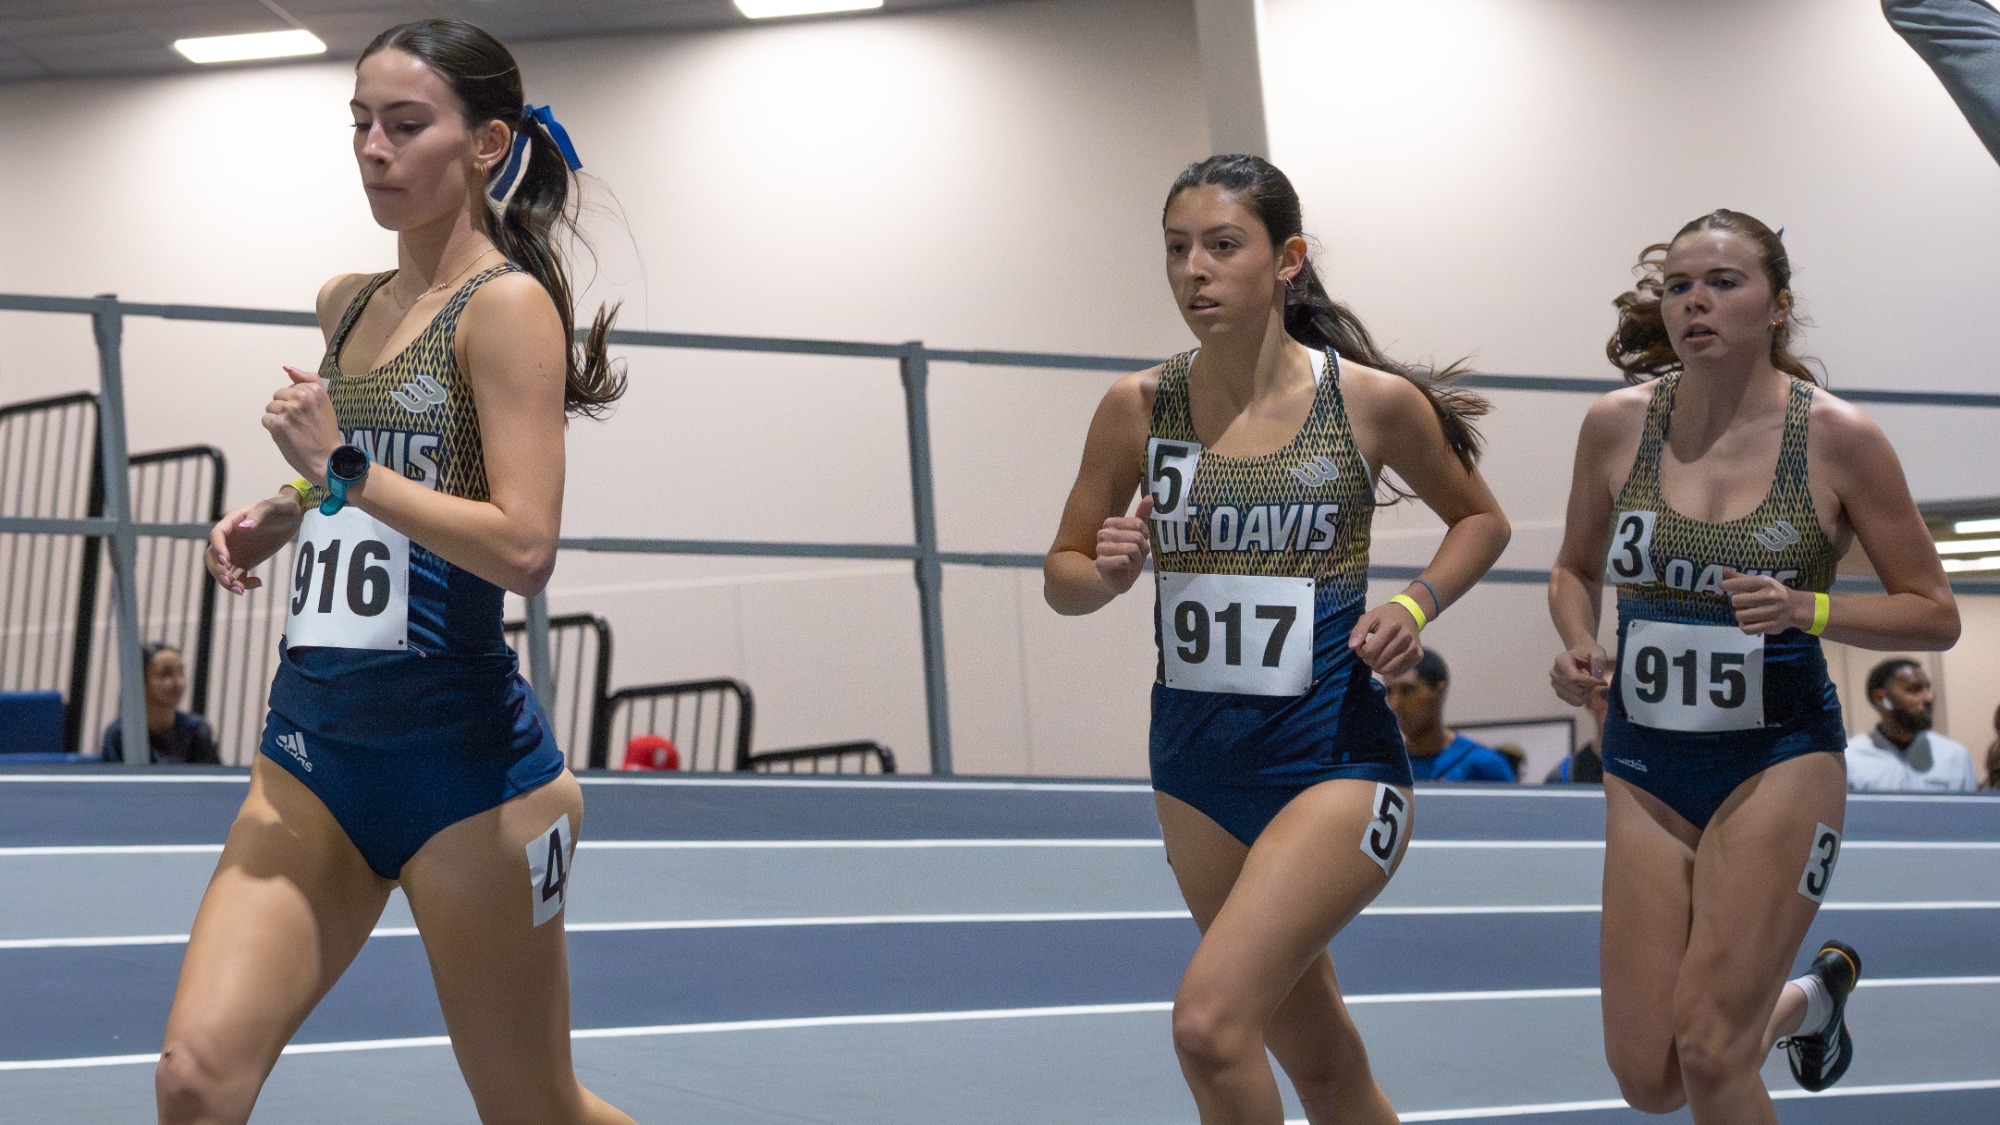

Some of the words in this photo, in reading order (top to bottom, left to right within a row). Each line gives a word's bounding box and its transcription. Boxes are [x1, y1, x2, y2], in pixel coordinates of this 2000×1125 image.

[1151, 443, 1189, 515] 5
[1211, 504, 1339, 551] DAVIS
[1612, 515, 1645, 578] 3
[291, 539, 391, 617] 916
[1174, 600, 1297, 668] 917
[1635, 646, 1747, 709] 915
[1370, 786, 1405, 861] 5
[541, 827, 567, 905] 4
[1806, 832, 1837, 896] 3
